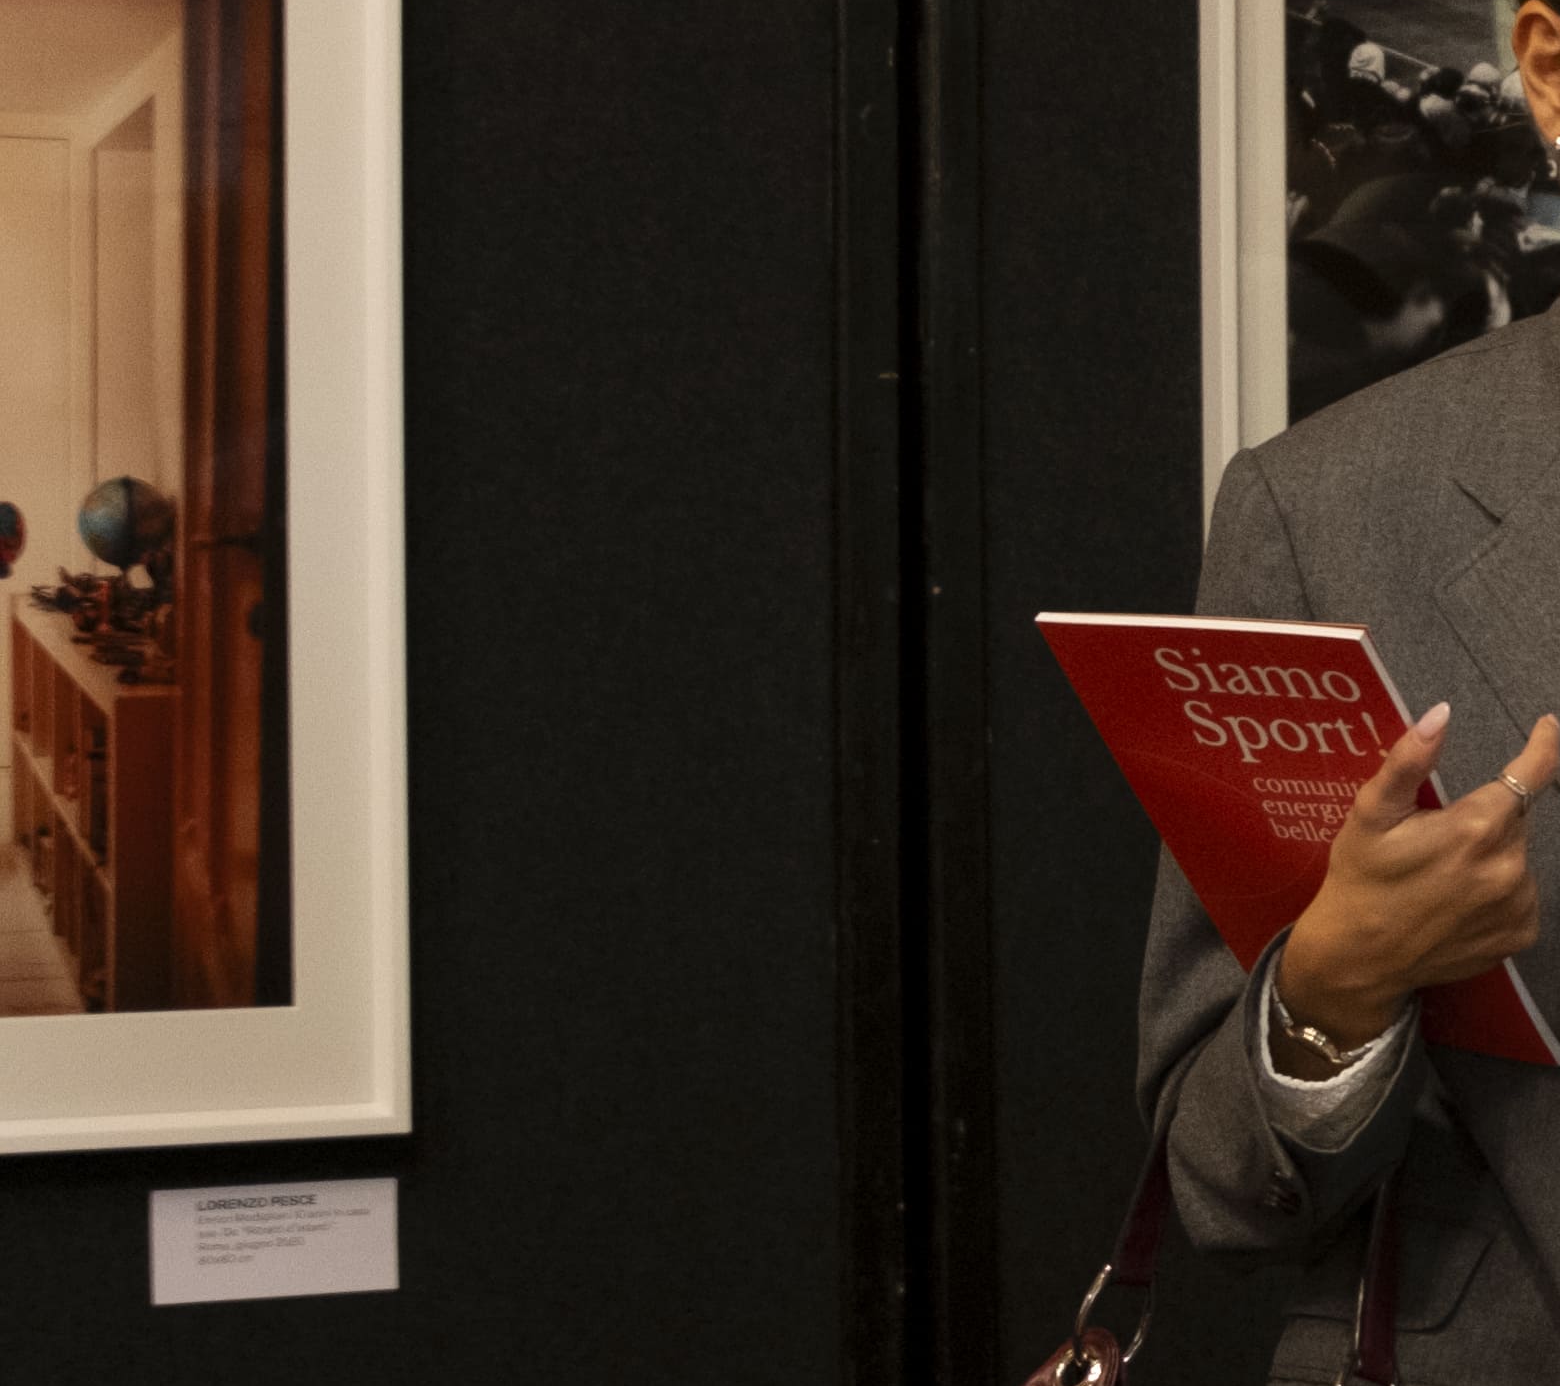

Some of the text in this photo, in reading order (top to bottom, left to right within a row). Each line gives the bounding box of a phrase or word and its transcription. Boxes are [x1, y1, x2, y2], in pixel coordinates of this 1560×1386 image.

[1154, 647, 1362, 703] Siamo
[1184, 699, 1389, 763] Sport!
[1253, 776, 1367, 798] comunit
[197, 1194, 318, 1212] LORENZO PESCE
